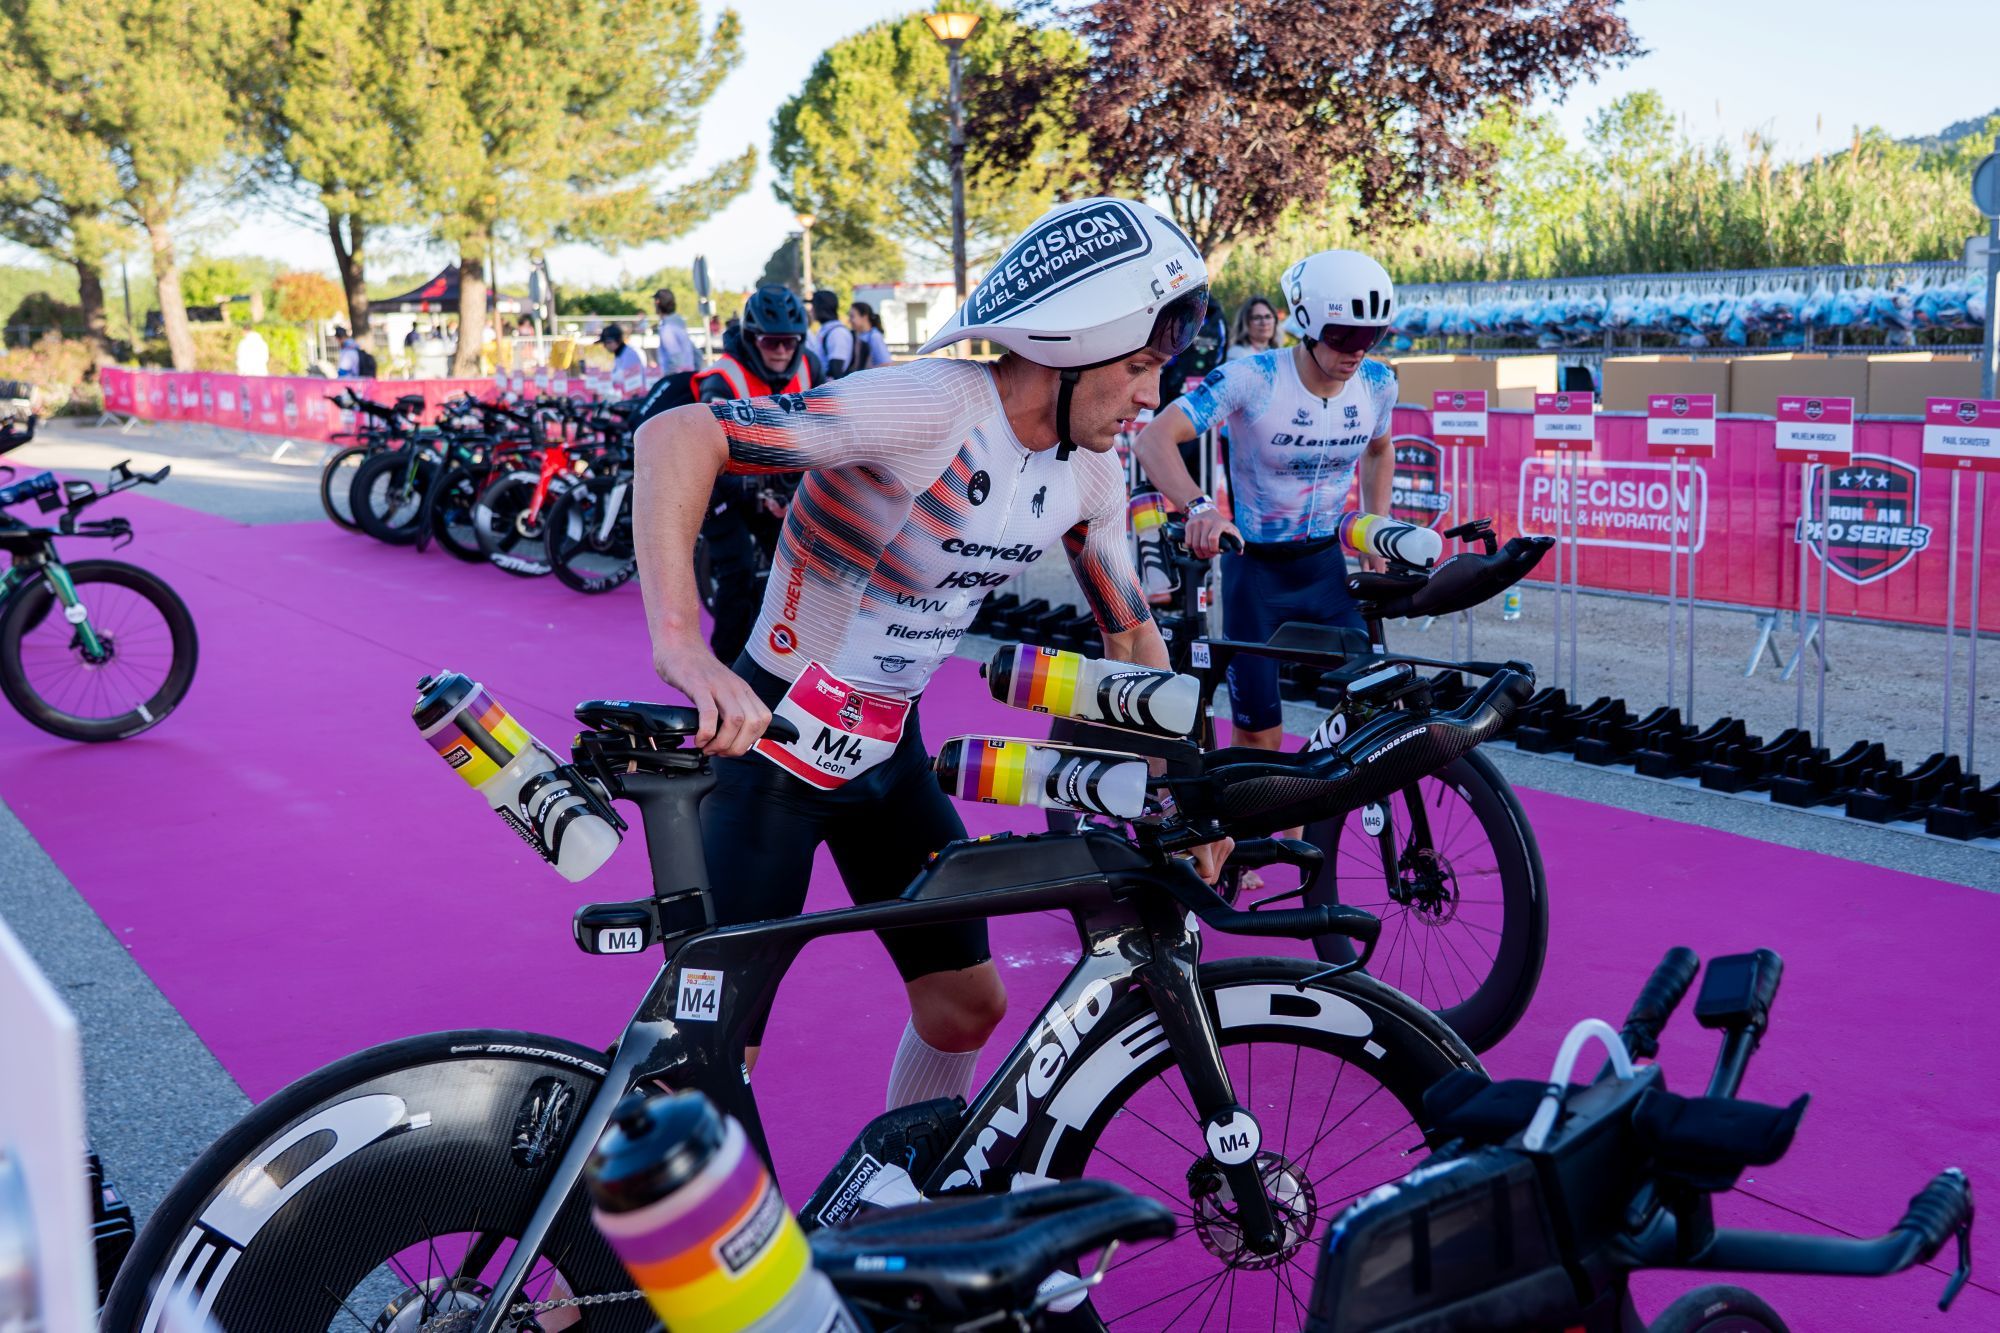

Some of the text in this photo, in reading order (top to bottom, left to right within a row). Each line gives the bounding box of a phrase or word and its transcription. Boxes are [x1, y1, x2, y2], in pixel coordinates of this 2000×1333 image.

[974, 211, 1121, 307] PRECISION
[1165, 259, 1184, 277] M4
[977, 228, 1128, 320] FUEL & HYDRATION
[1293, 434, 1369, 447] Lassalle
[1942, 435, 1991, 448] PAUL SCHUSTER
[1532, 476, 1690, 513] PRECISION
[1577, 510, 1589, 526] &
[1591, 511, 1689, 534] HYDRATION
[1846, 524, 1927, 547] SERIES
[934, 570, 1011, 589] HOKA
[1193, 650, 1209, 665] M46
[1111, 671, 1152, 680] GORILLA
[811, 726, 863, 766] M4
[1367, 726, 1427, 764] DRAG2ZERO
[815, 754, 847, 775] Leon
[1364, 816, 1381, 827] M46
[608, 931, 638, 950] M4
[681, 987, 716, 1014] M4
[486, 1044, 545, 1057] GRAND
[542, 1050, 583, 1066] PRIX
[1218, 1132, 1250, 1154] M4
[825, 1162, 874, 1224] PRECISION
